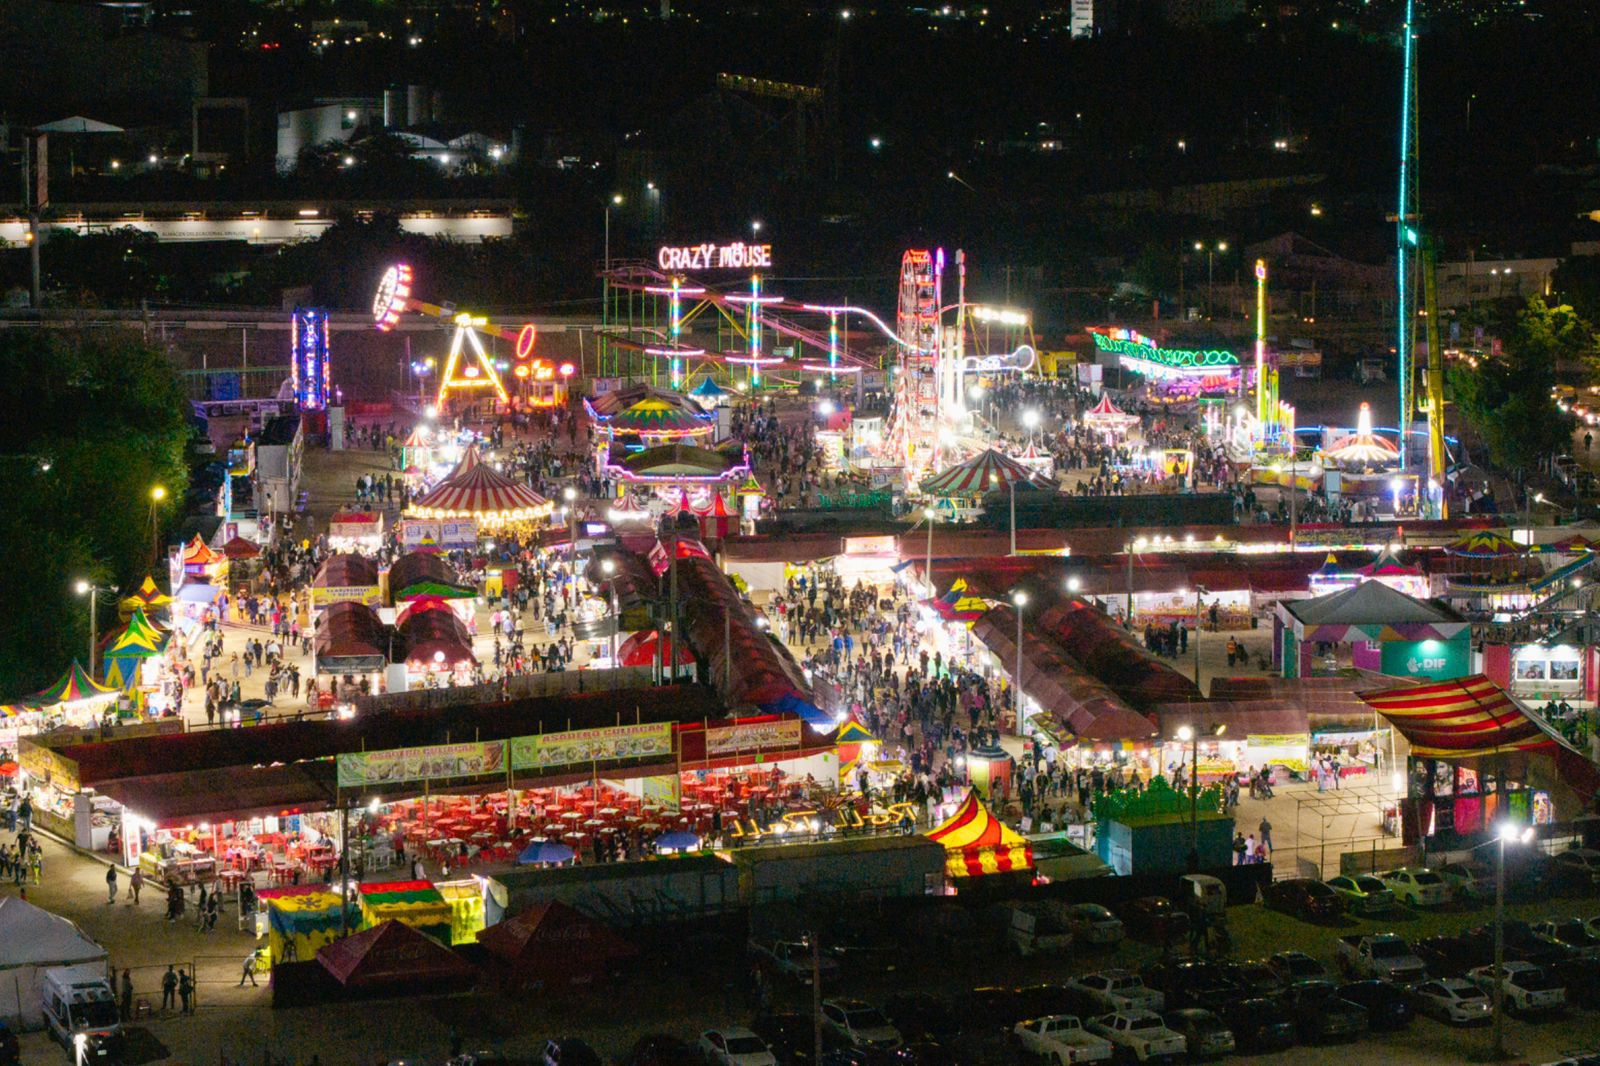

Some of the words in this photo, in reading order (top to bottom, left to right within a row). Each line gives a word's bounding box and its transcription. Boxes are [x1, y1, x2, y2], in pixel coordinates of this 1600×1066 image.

[659, 244, 715, 269] CRAZY
[719, 242, 771, 268] MOUSE
[1423, 658, 1446, 669] DIF
[542, 730, 600, 744] ASADERO
